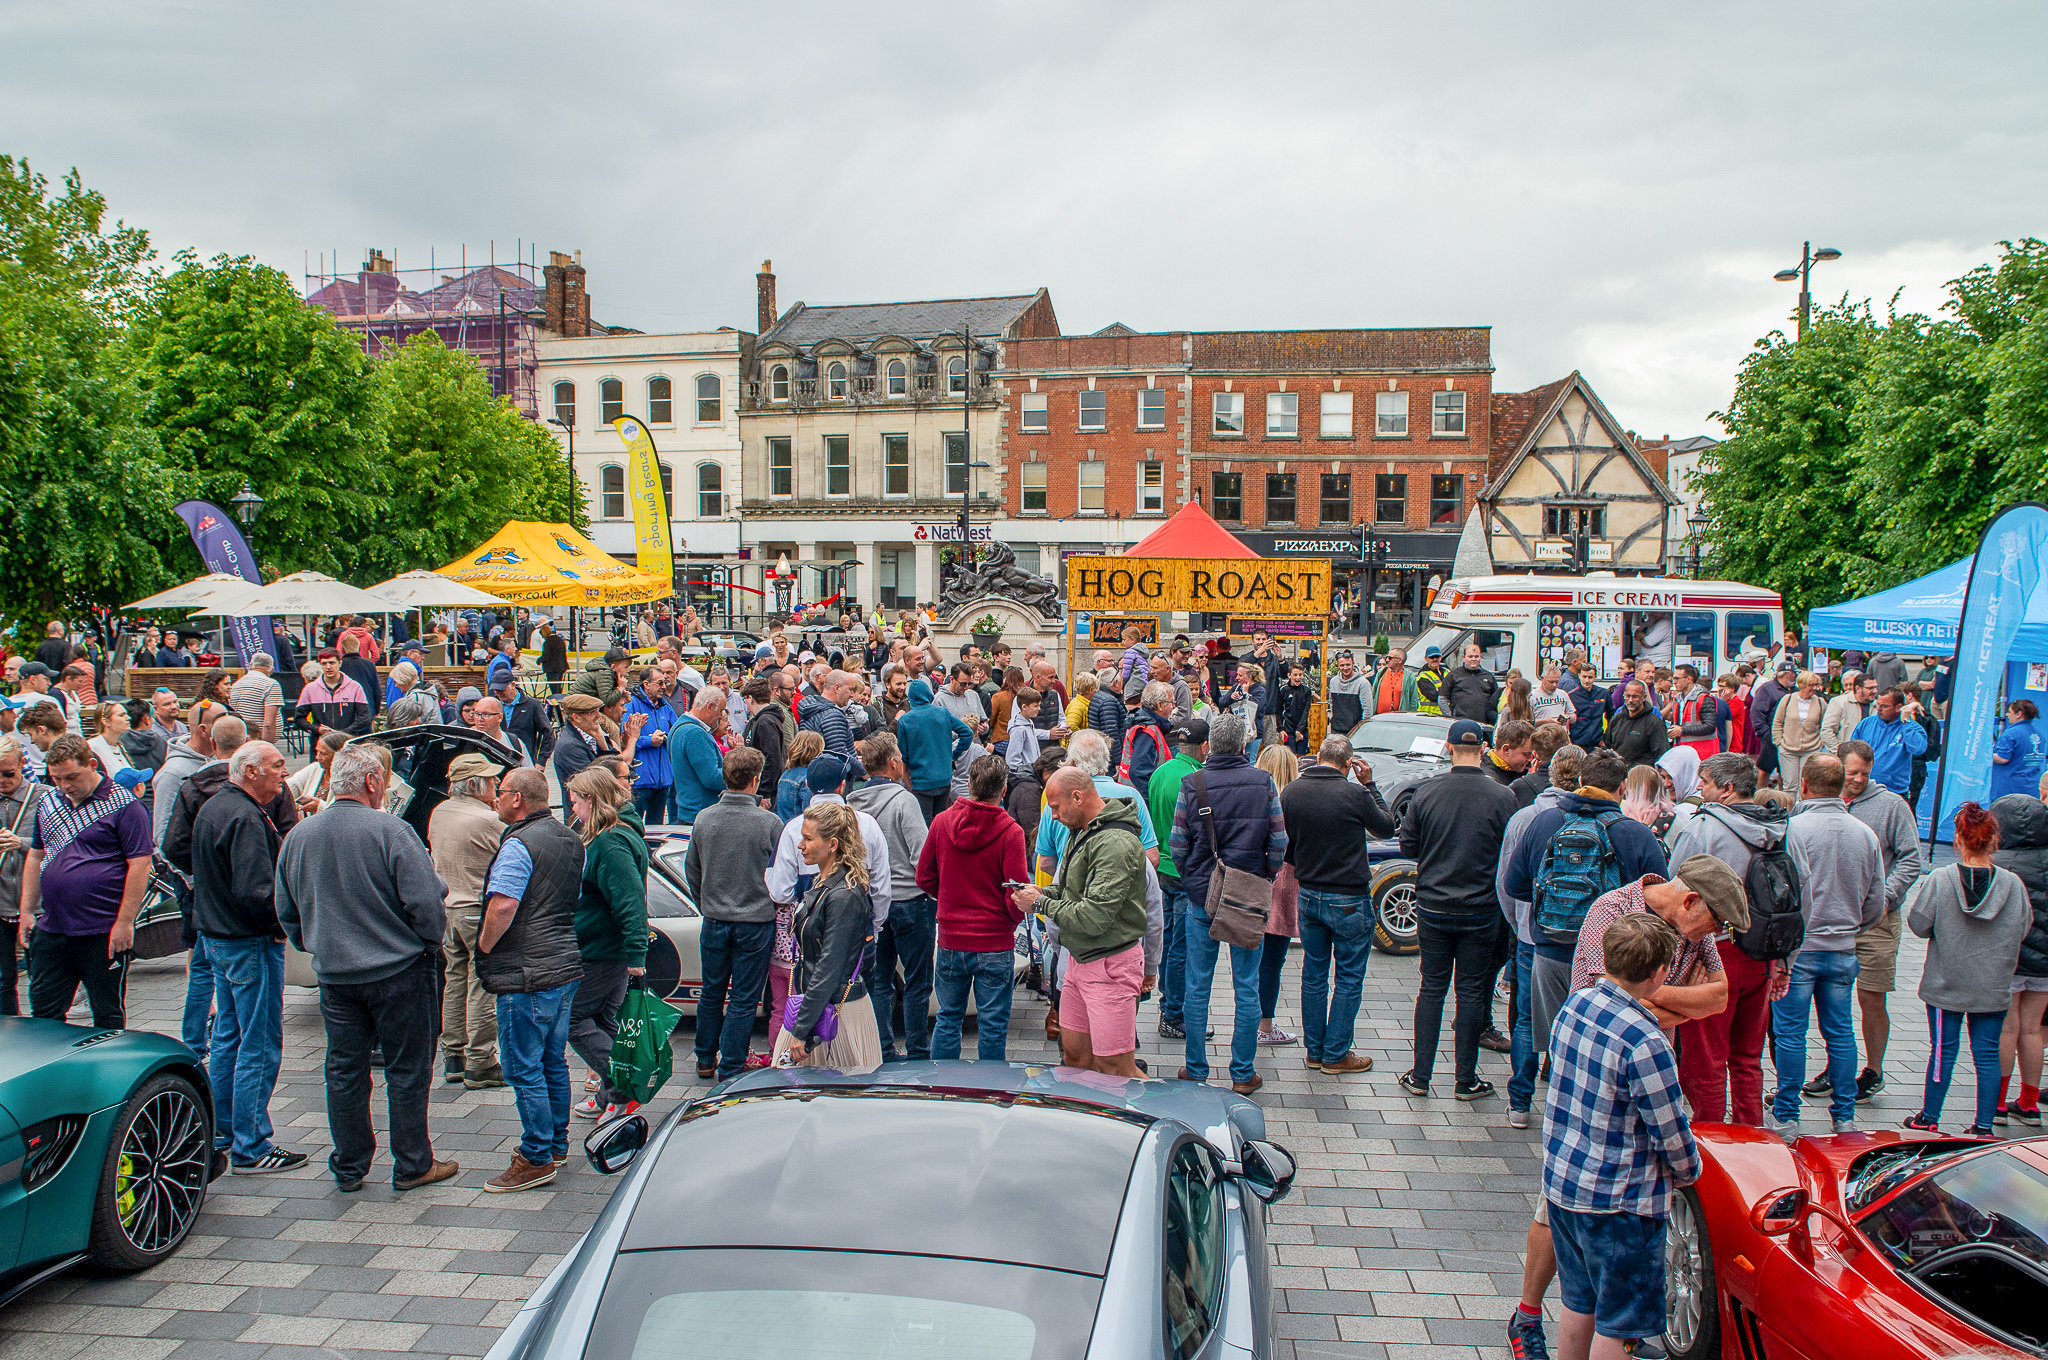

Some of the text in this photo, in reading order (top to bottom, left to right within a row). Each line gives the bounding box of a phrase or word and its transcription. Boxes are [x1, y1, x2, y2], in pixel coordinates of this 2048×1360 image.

[492, 573, 553, 583] RIDES
[1077, 569, 1321, 601] HOG ROAST
[490, 588, 558, 600] bears.co.uk
[1577, 591, 1679, 606] ICE CREAM
[1095, 622, 1122, 638] HOG
[1864, 619, 1924, 637] BLUESKY
[1374, 922, 1394, 948] PIREL
